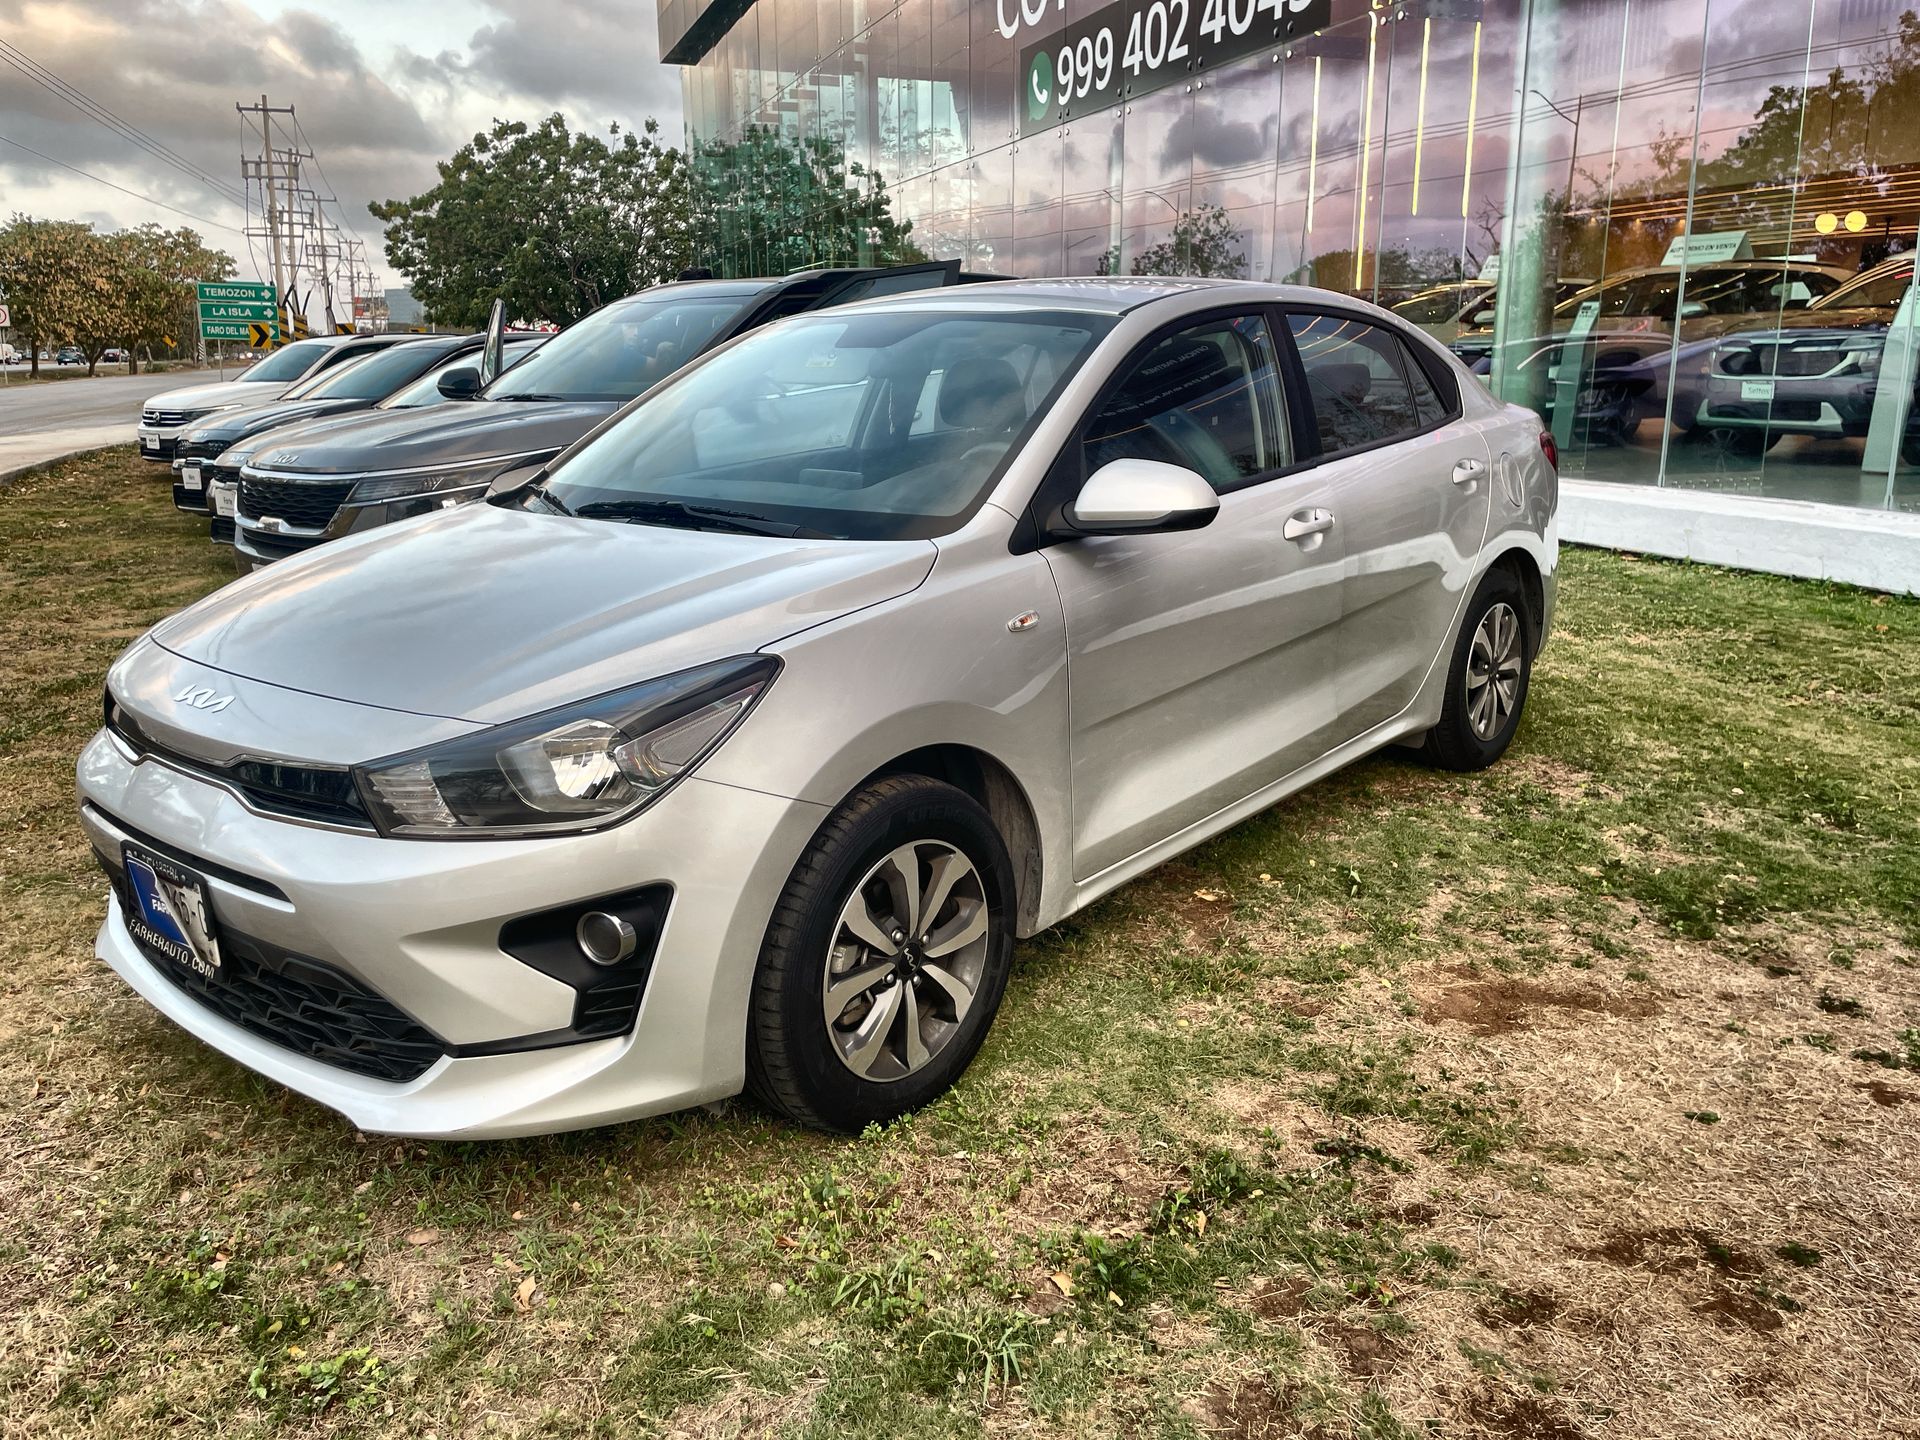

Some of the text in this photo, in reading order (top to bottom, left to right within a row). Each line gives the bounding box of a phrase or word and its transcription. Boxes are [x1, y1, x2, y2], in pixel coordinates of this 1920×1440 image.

[1057, 27, 1113, 106] 999
[1122, 0, 1189, 76] 402
[1200, 0, 1313, 43] 40
[204, 287, 256, 298] TEMOZON
[212, 307, 252, 317] LA ISLA
[207, 326, 250, 336] FARO DEL MA
[173, 683, 237, 714] KIA
